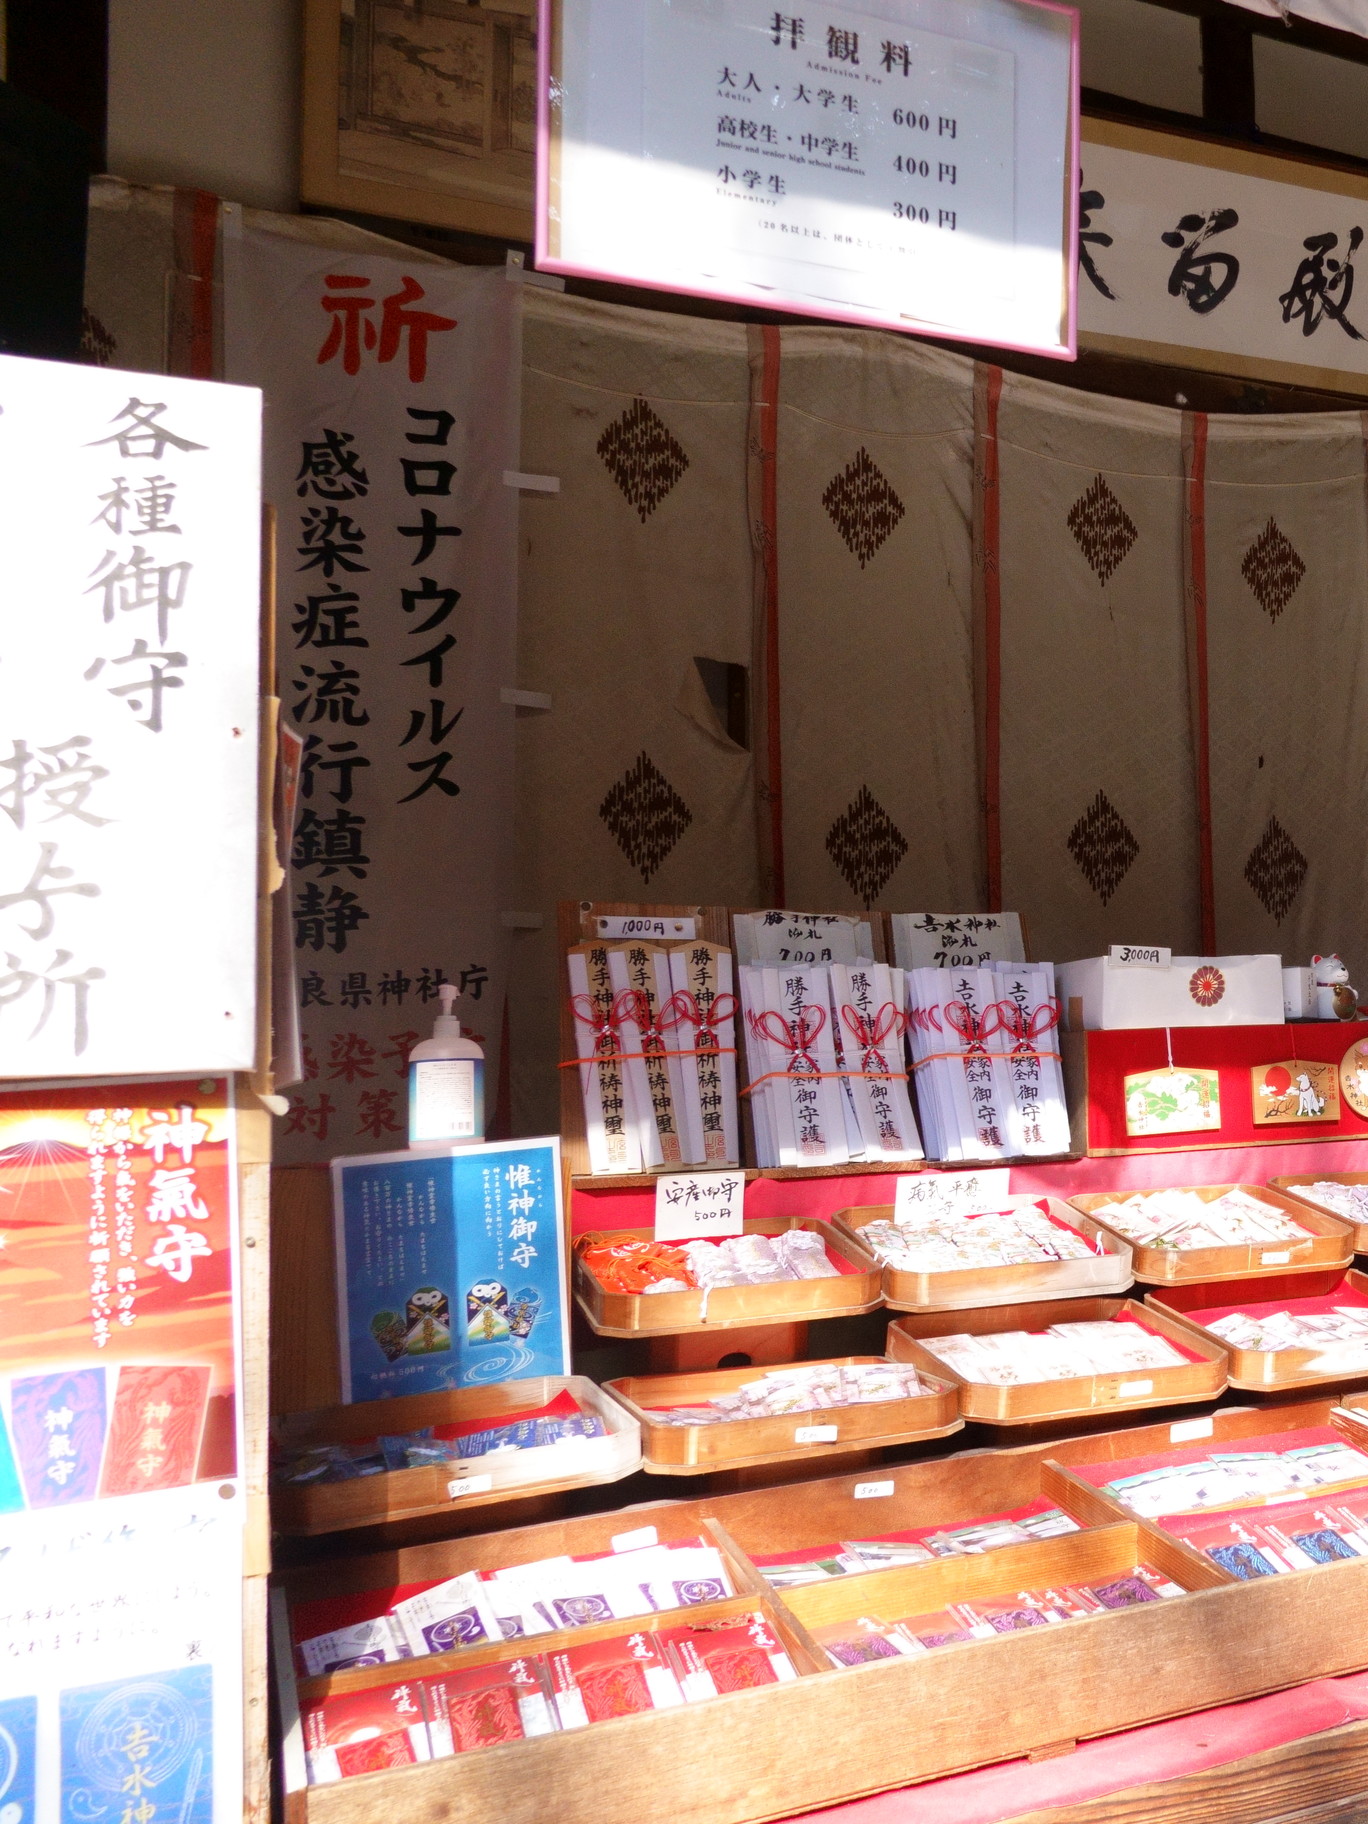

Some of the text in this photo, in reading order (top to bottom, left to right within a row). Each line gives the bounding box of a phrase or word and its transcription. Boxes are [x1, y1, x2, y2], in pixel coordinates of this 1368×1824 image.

[770, 12, 913, 77] 拝観料
[717, 67, 859, 115] 大人・大学生
[717, 89, 752, 103] Adults
[807, 61, 883, 85] Admission Fee
[716, 139, 866, 176] Junior and senior high school students
[717, 115, 859, 162] 高校生・中学生
[716, 188, 778, 207] Elementary
[717, 164, 786, 196] 小学生
[317, 274, 458, 383] 祈
[82, 397, 210, 734] 各種御守
[397, 406, 465, 805] コロナウイルス
[292, 429, 371, 954] 感染症流行鎮静
[143, 1104, 213, 1283] 神氣守
